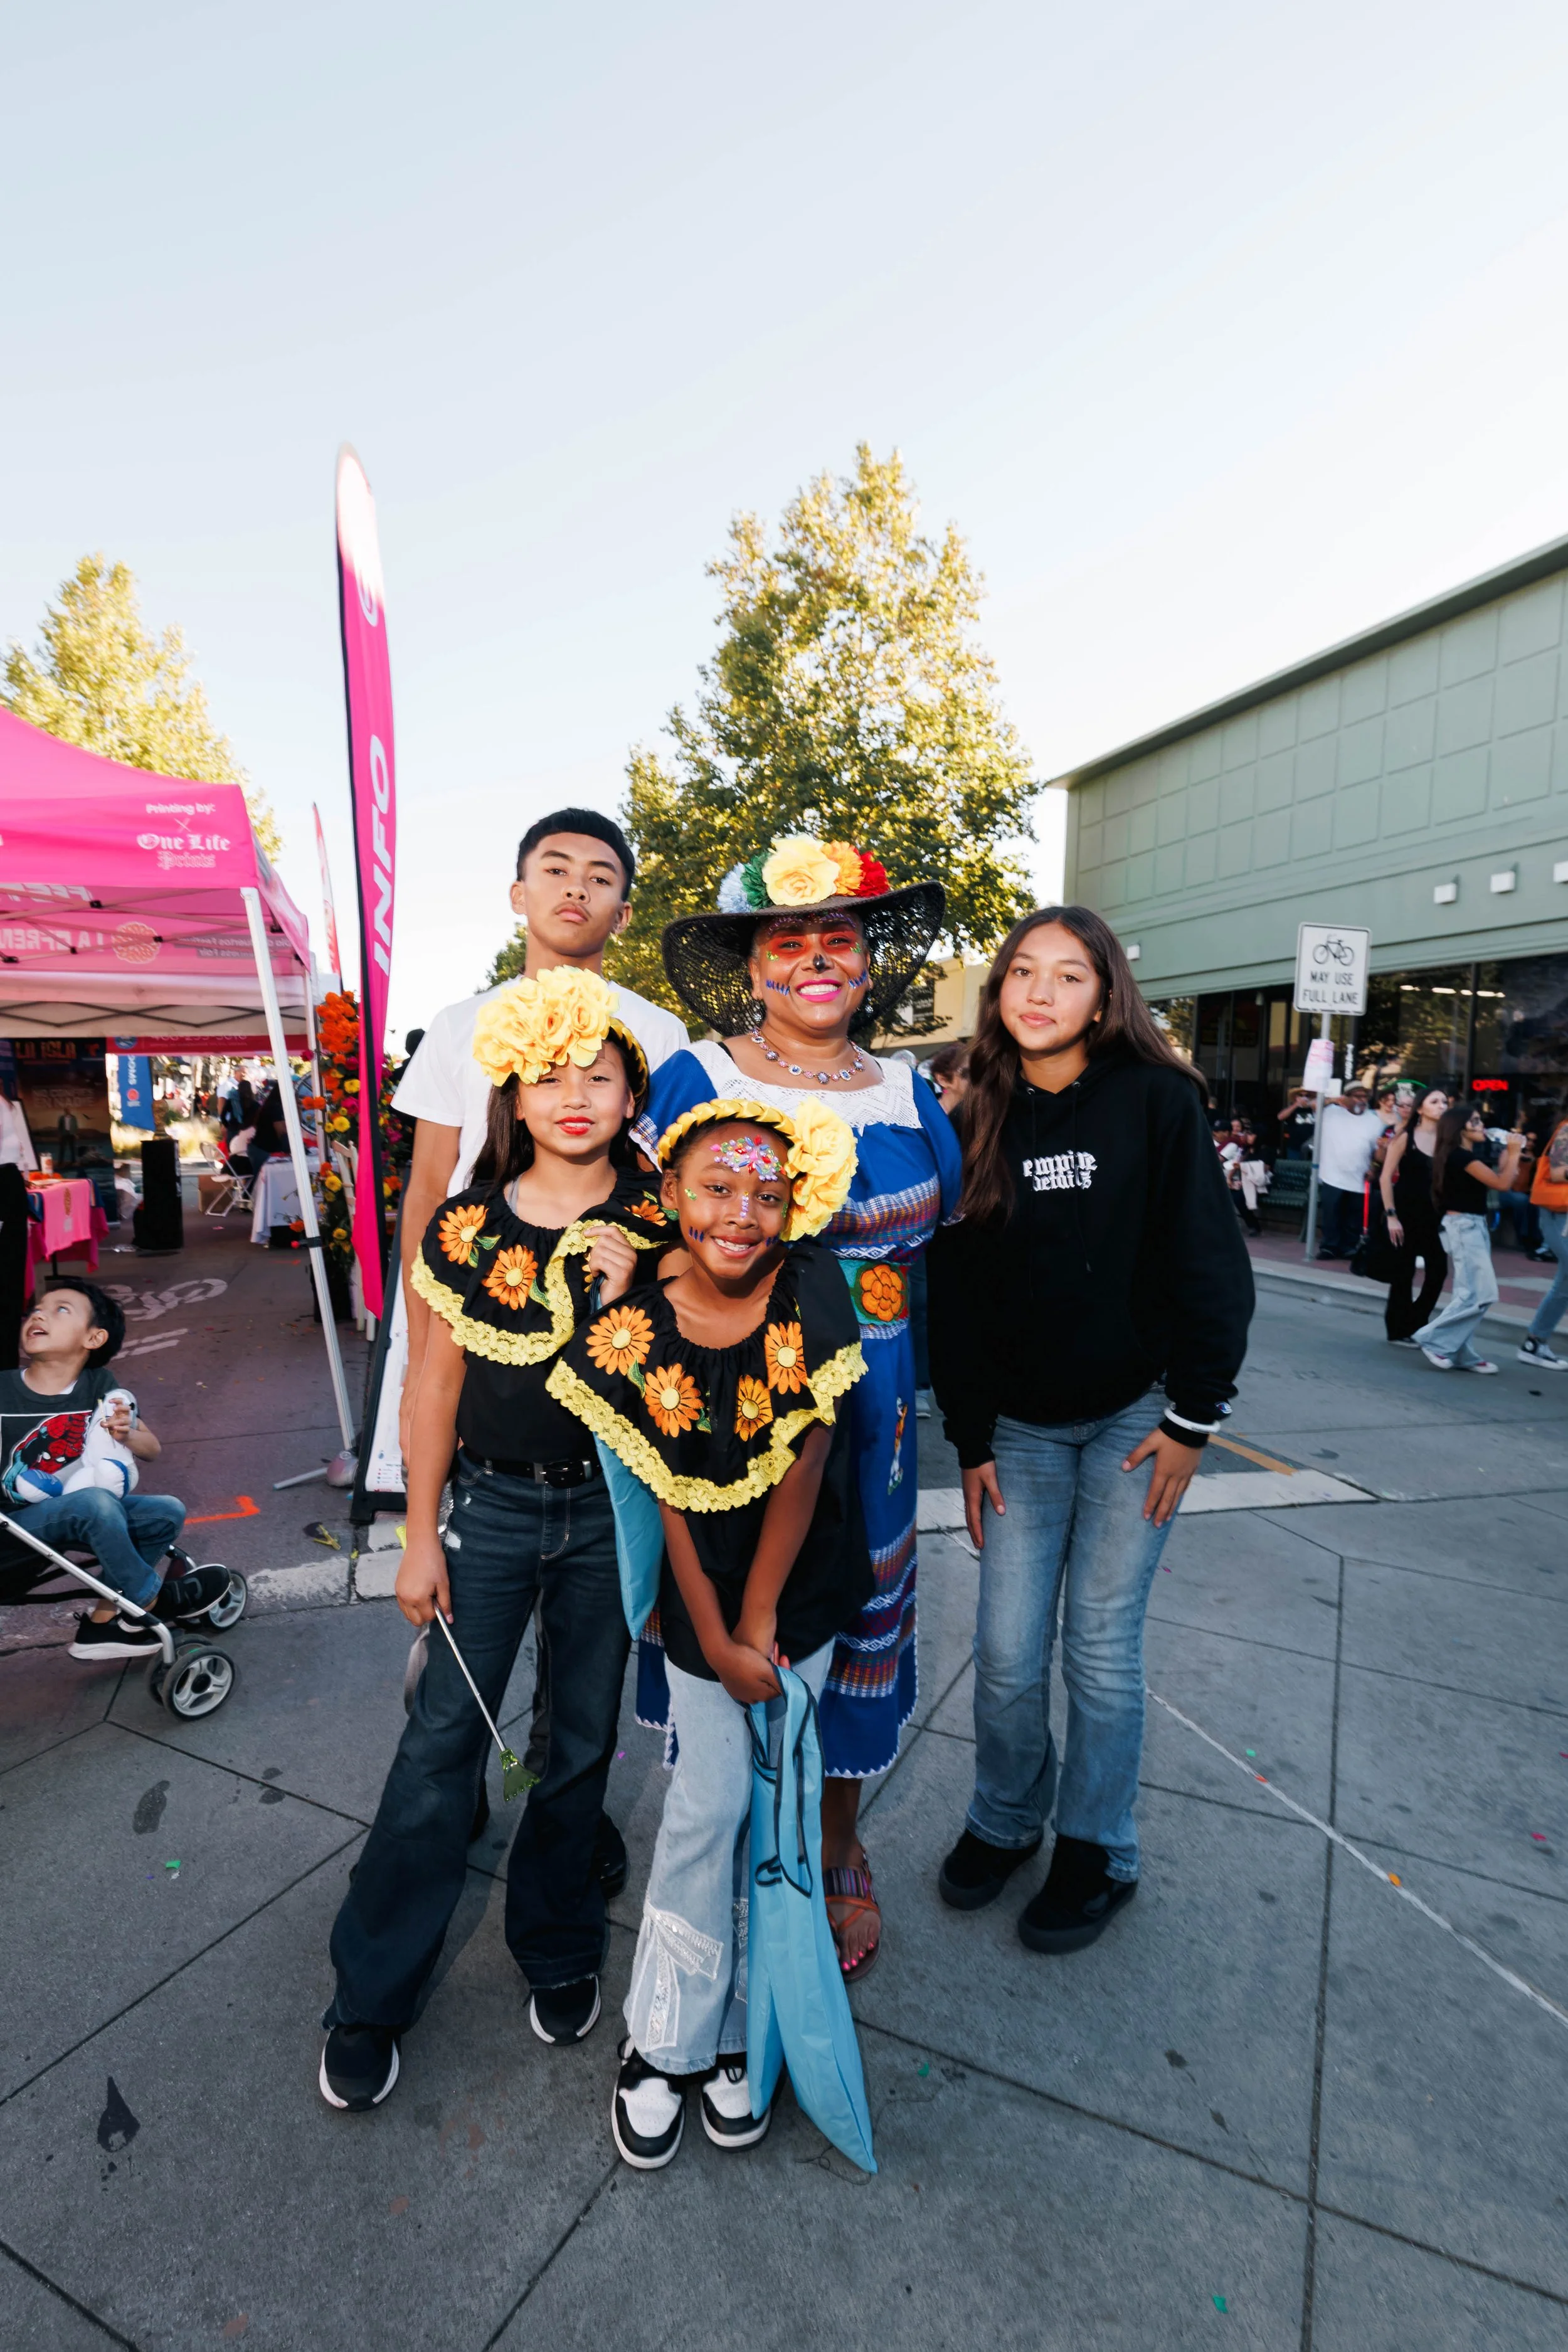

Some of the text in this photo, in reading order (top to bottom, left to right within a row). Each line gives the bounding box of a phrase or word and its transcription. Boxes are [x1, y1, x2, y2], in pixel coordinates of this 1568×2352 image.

[146, 803, 195, 815] Printing
[136, 833, 231, 851] One Life
[157, 850, 216, 871] Prints
[369, 734, 393, 976] INFO
[1310, 970, 1354, 986] MAY USE
[1303, 989, 1359, 1005] FULL LANE
[1472, 1079, 1508, 1091] OPEN
